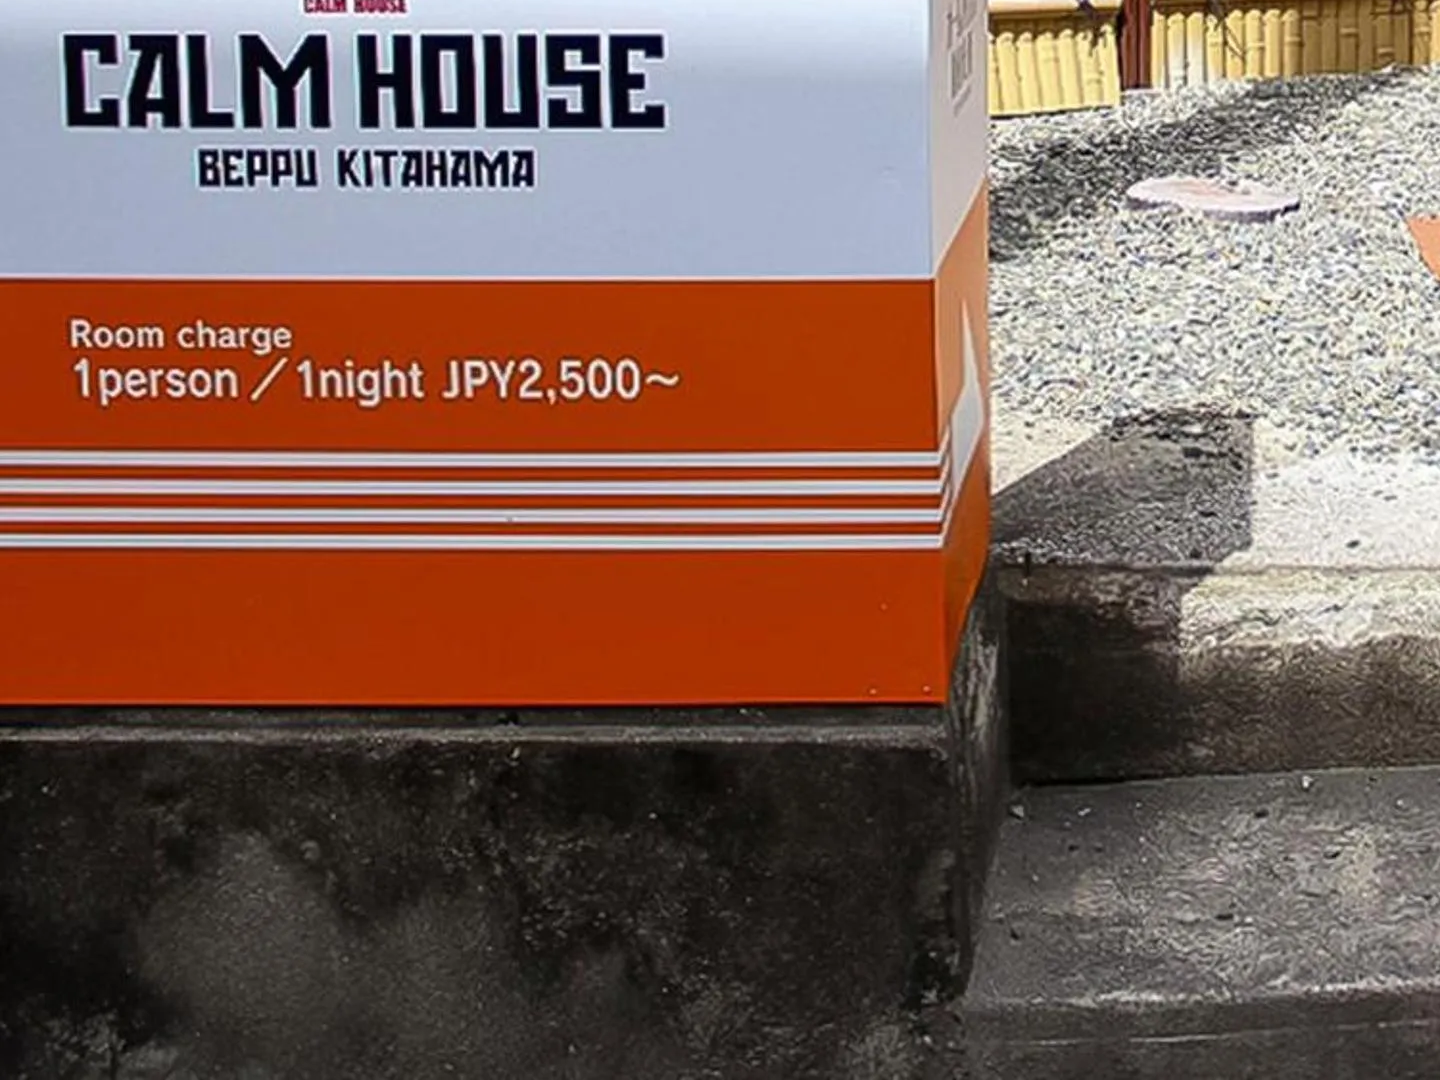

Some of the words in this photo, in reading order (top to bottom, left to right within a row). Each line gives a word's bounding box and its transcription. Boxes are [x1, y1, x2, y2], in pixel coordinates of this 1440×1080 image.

[63, 34, 331, 128] CALM
[357, 34, 666, 128] HOUSE
[199, 149, 318, 187] BEPPU
[337, 150, 536, 187] KITAHAMA
[70, 320, 165, 348] Room
[178, 320, 292, 355] charge
